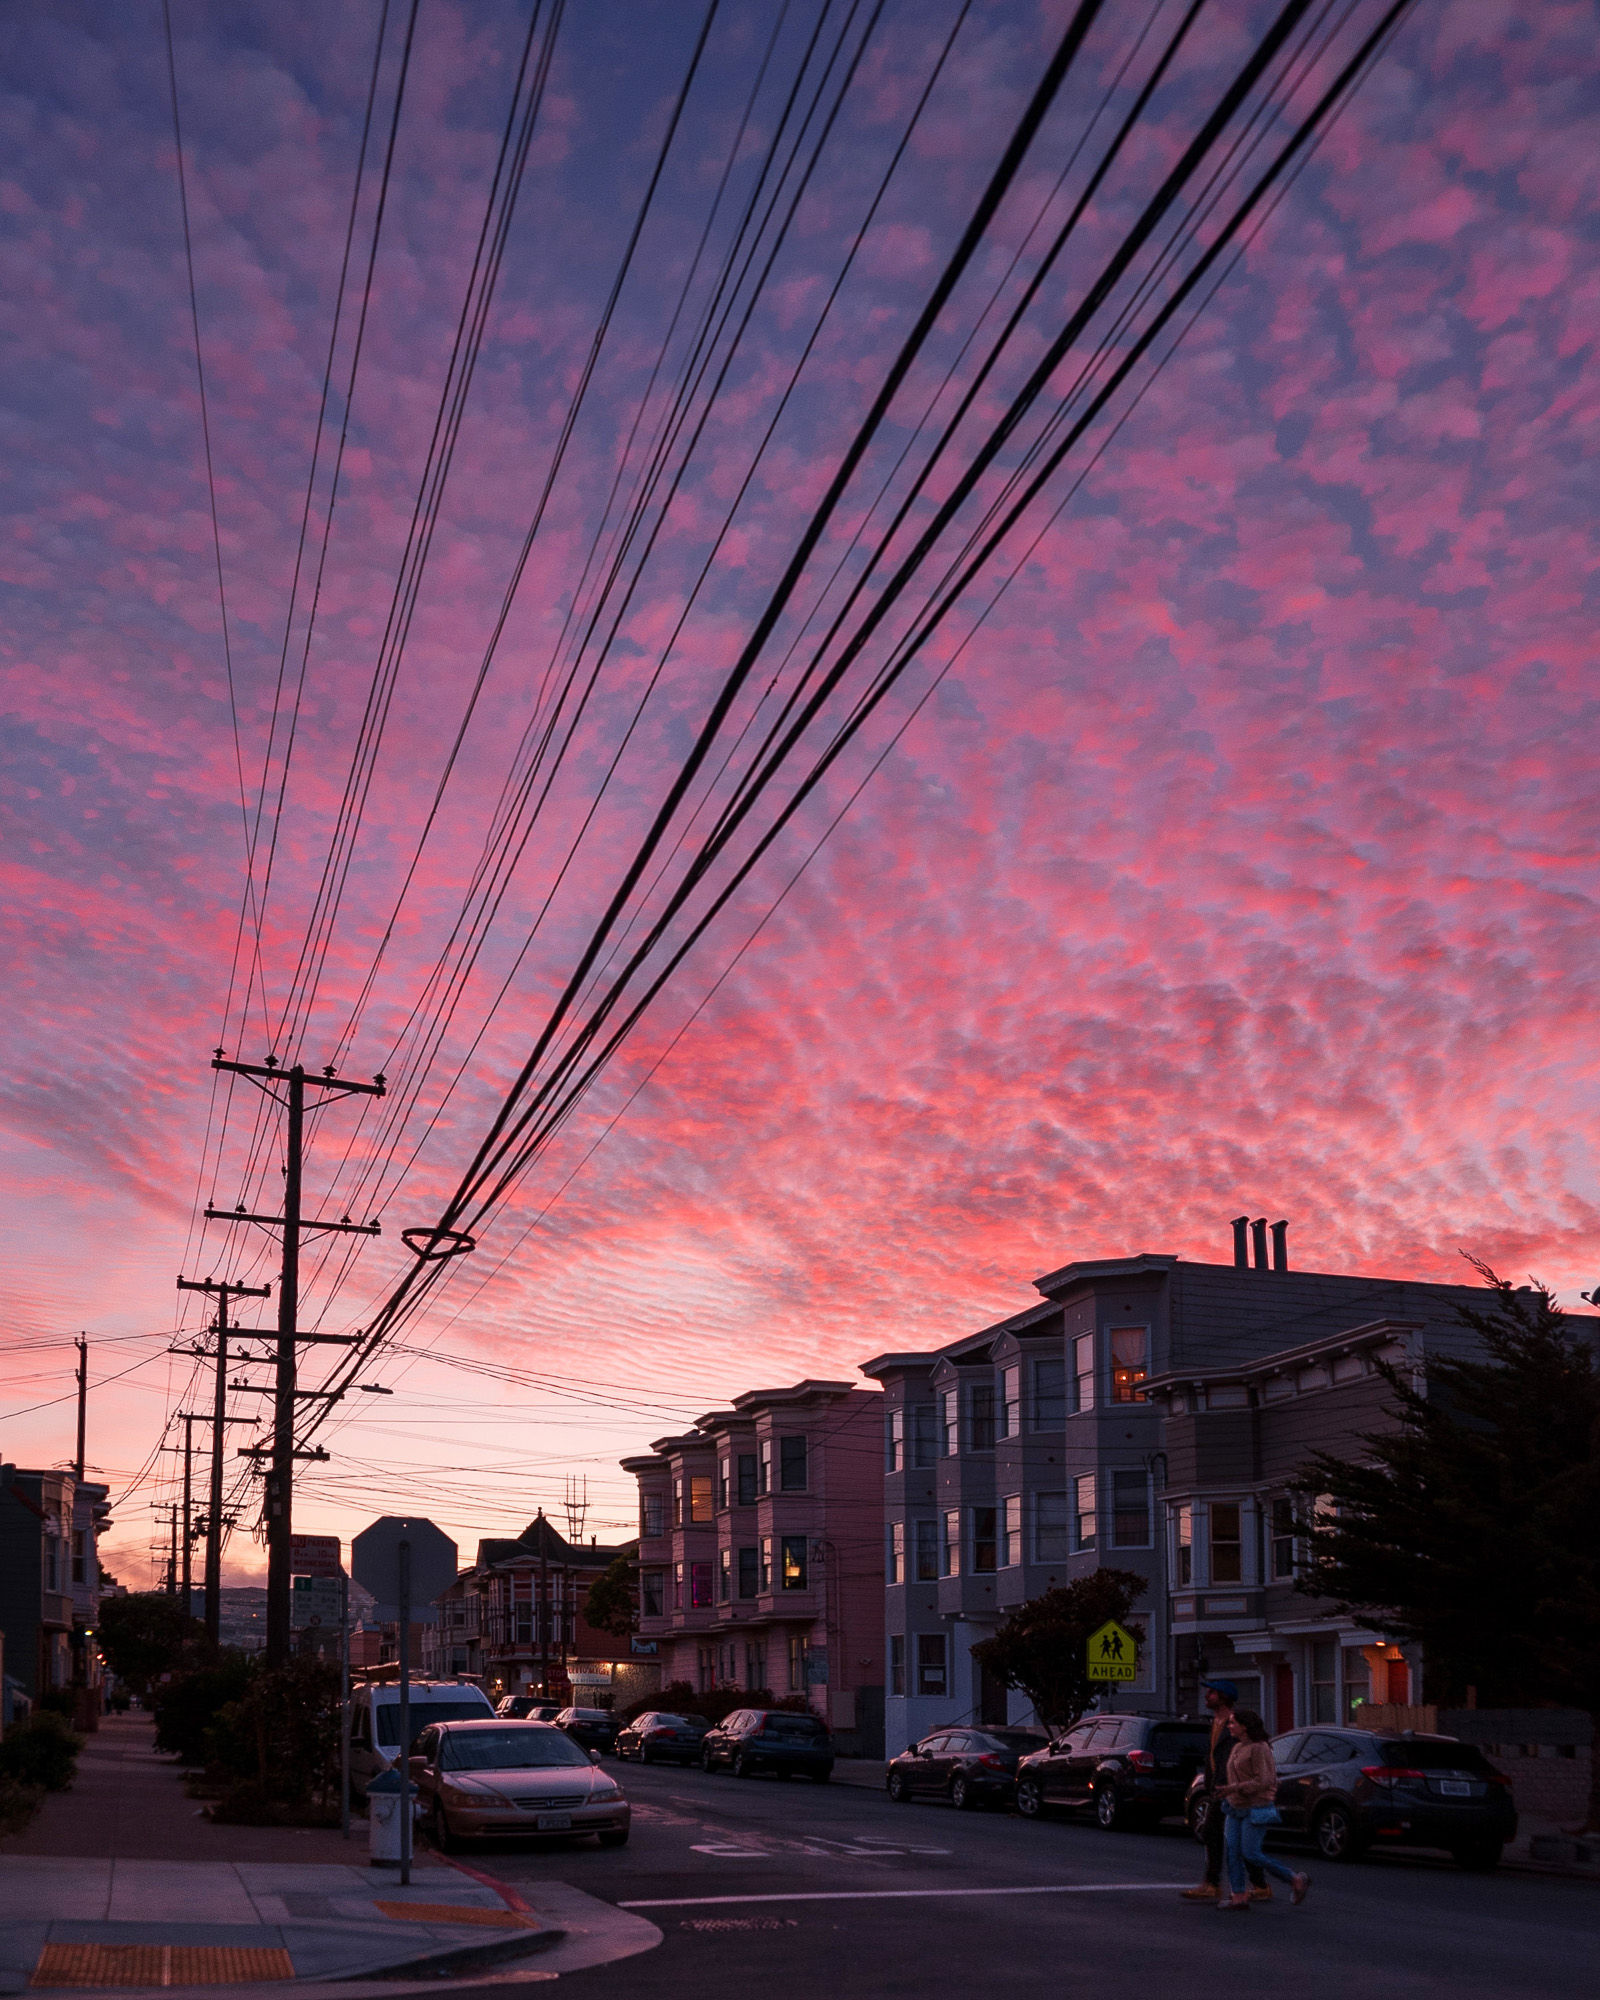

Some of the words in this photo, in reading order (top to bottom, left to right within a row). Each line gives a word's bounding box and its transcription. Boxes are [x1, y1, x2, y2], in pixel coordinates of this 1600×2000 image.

[292, 1536, 304, 1547] NO
[307, 1538, 337, 1548] PARKING
[293, 1559, 336, 1568] WEDNESDAY
[546, 1669, 566, 1677] STOP
[1092, 1667, 1132, 1677] AHEAD
